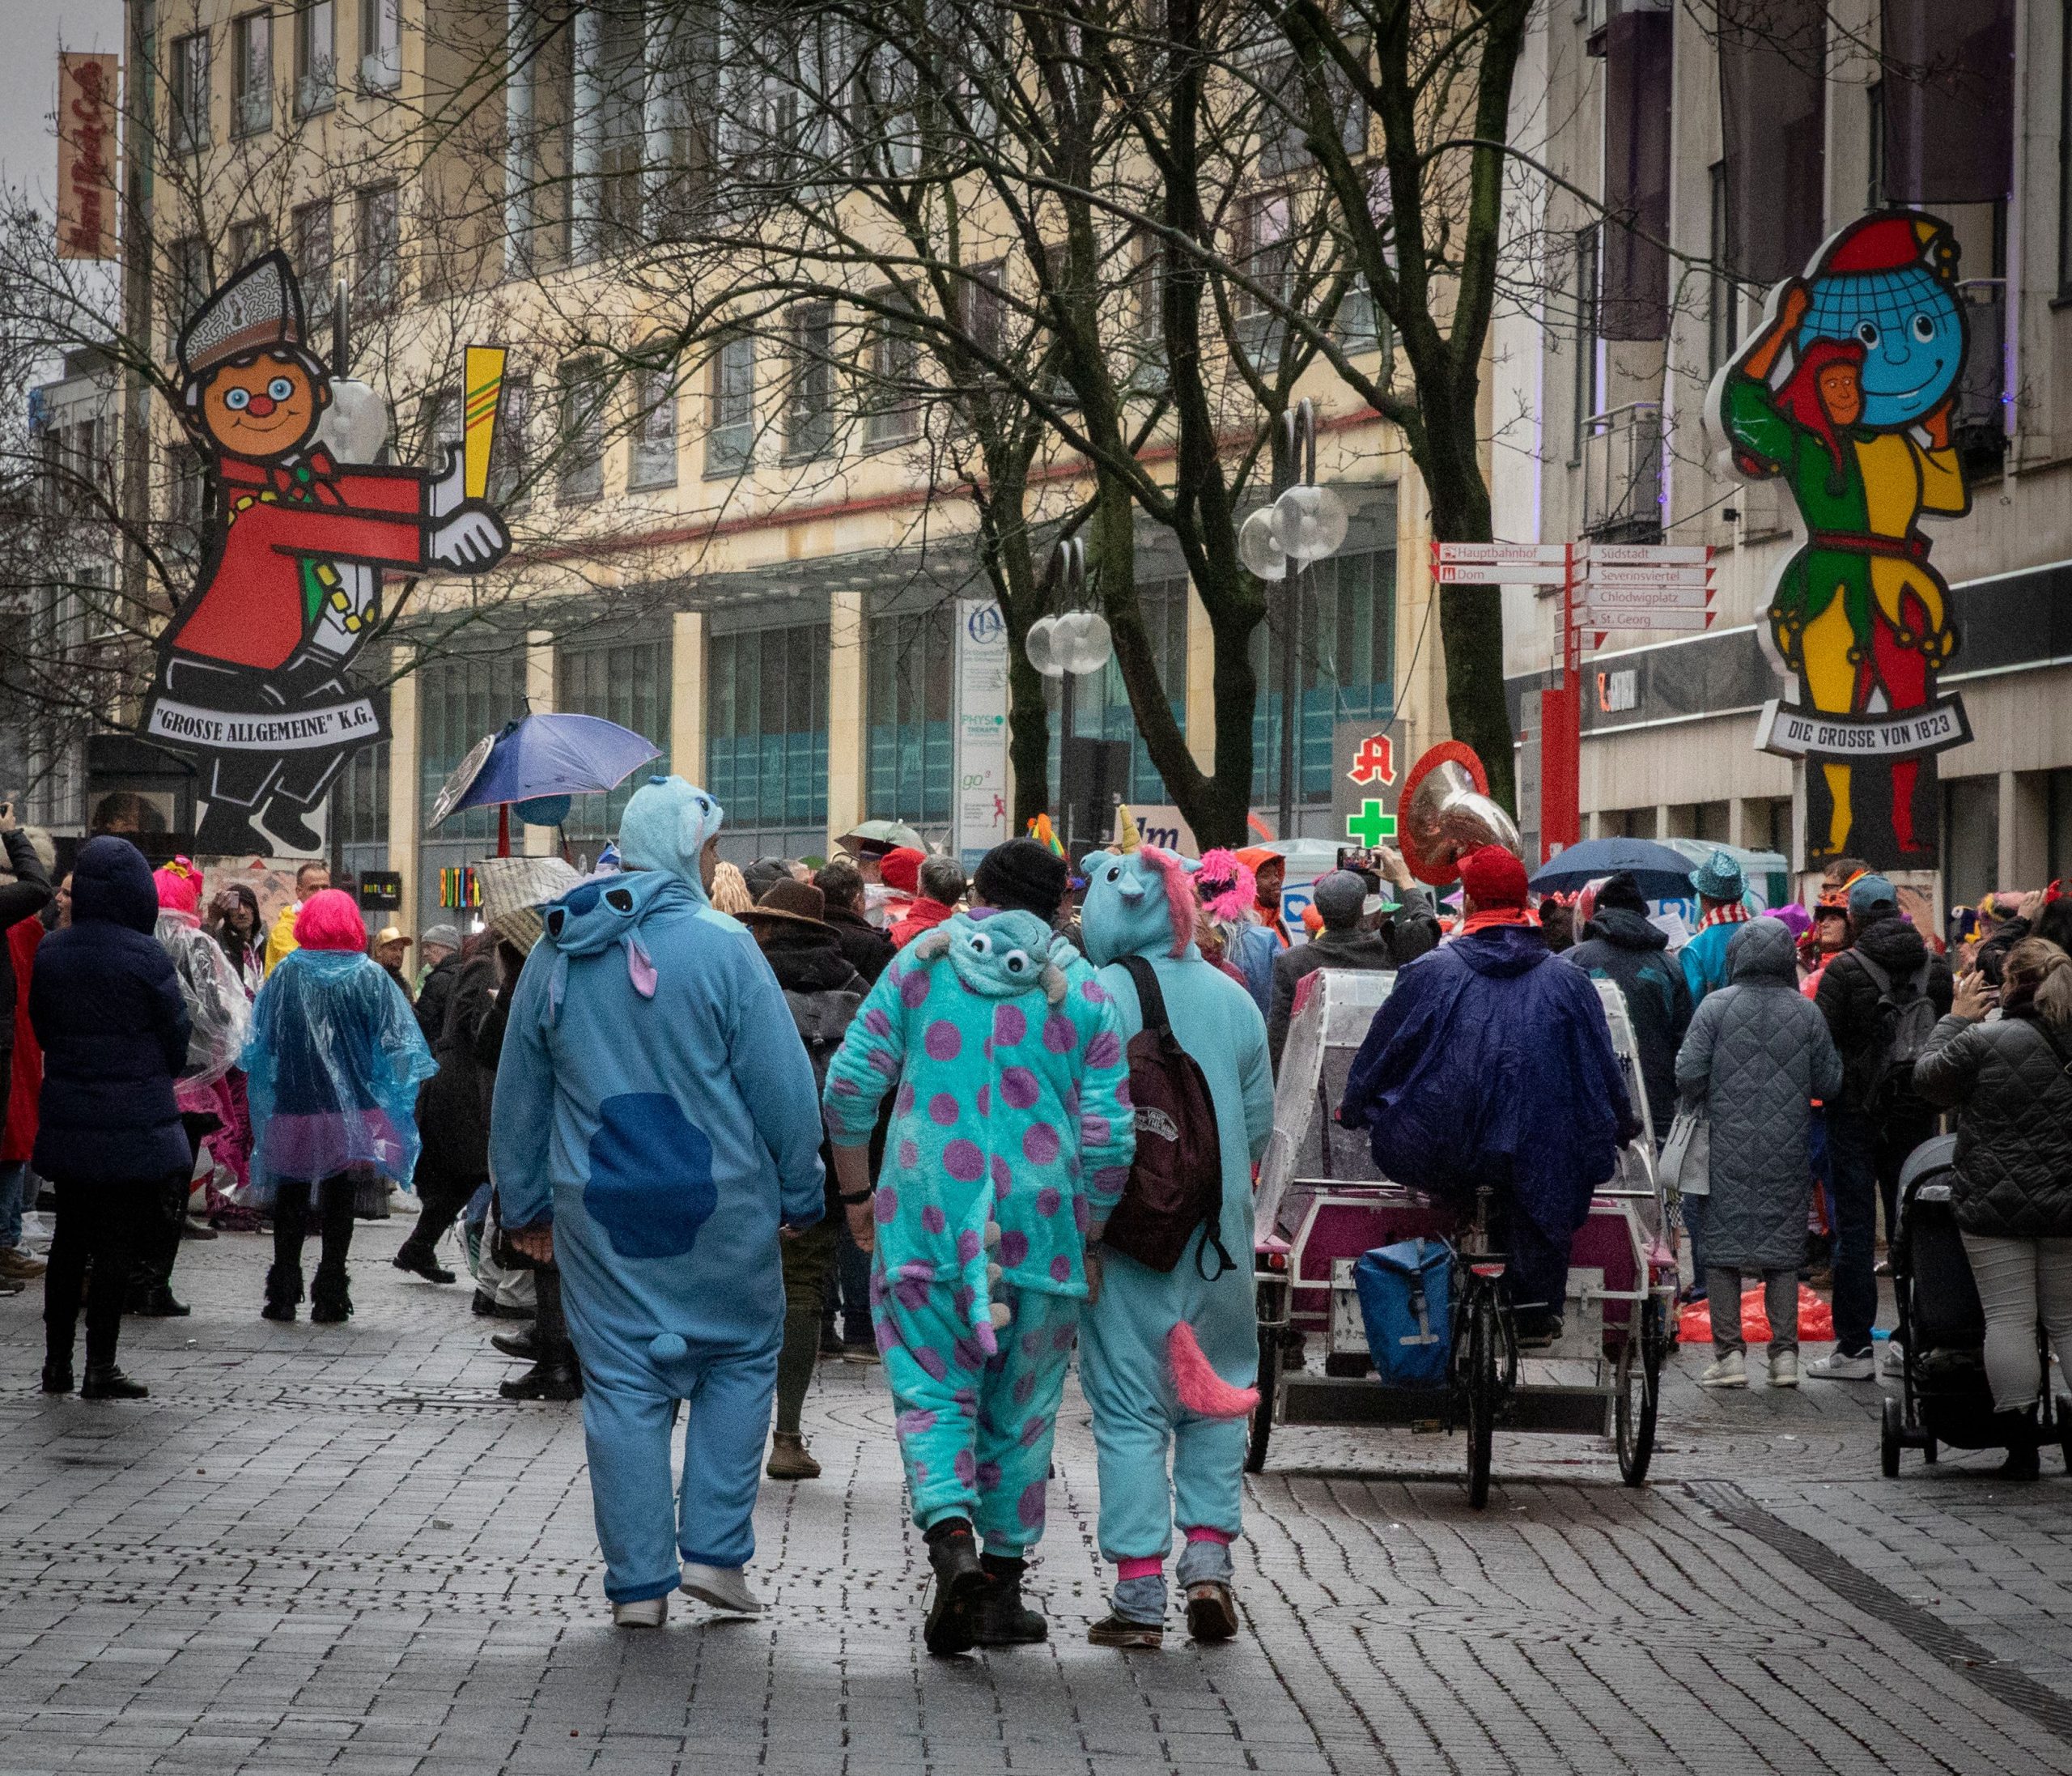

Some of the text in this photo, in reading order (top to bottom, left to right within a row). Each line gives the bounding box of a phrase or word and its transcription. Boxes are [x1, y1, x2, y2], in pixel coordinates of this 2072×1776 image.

[1458, 548, 1537, 559] Hauptbahnhof
[1601, 548, 1650, 559] Südstadt
[1458, 569, 1484, 580] Dom
[1601, 570, 1679, 580] Severinsviertel
[1600, 591, 1679, 603] Chlodwigplatz
[1601, 614, 1651, 627] St. Georg
[156, 706, 373, 742] "GROSSE ALLGEMEINE" K.G.
[1788, 720, 1813, 742] DIE
[1880, 724, 1912, 746] VON
[1914, 715, 1951, 740] 1823
